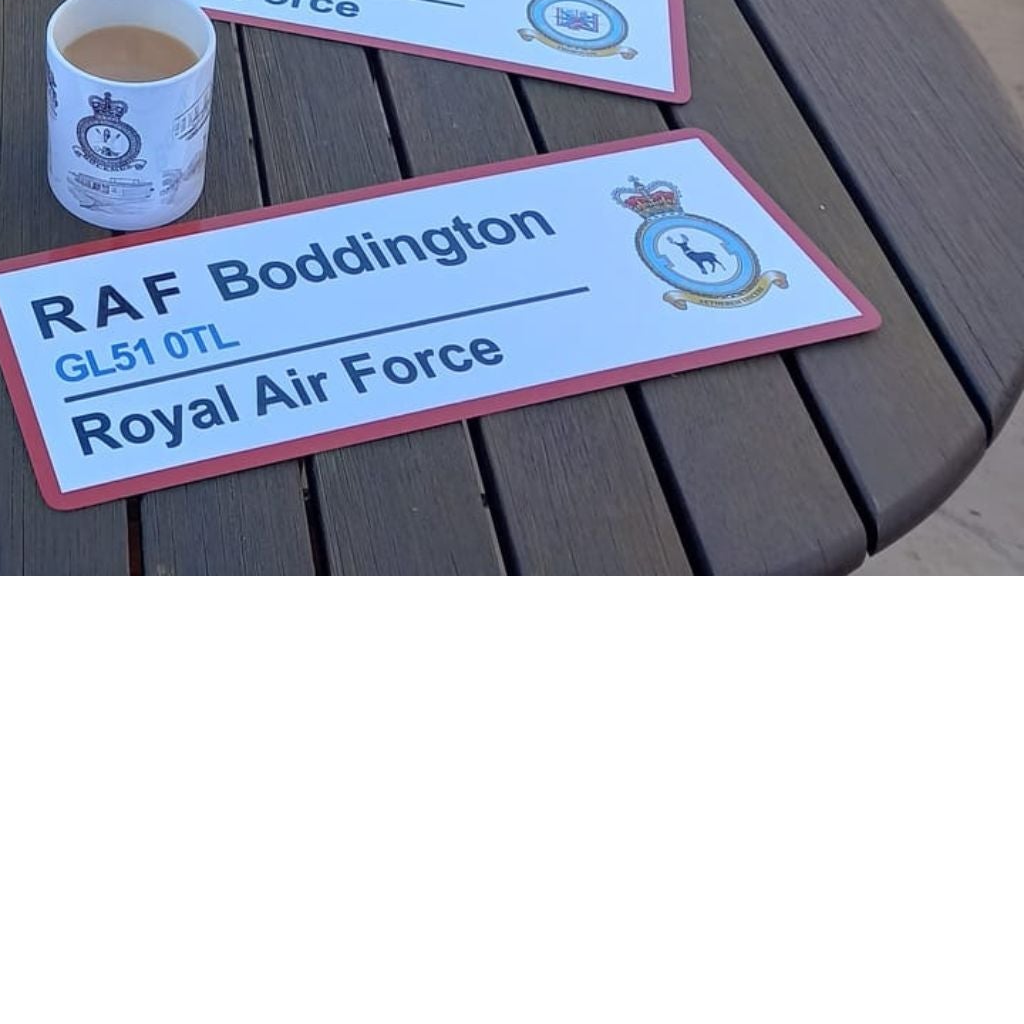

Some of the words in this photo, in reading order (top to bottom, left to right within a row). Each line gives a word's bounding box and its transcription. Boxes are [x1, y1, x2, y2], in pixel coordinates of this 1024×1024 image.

[31, 272, 181, 341] RAF
[206, 209, 557, 303] Boddington
[56, 337, 156, 383] GL51
[164, 324, 241, 360] 0TL
[71, 383, 240, 457] Royal
[256, 372, 329, 417] Air
[339, 337, 504, 395] Force
